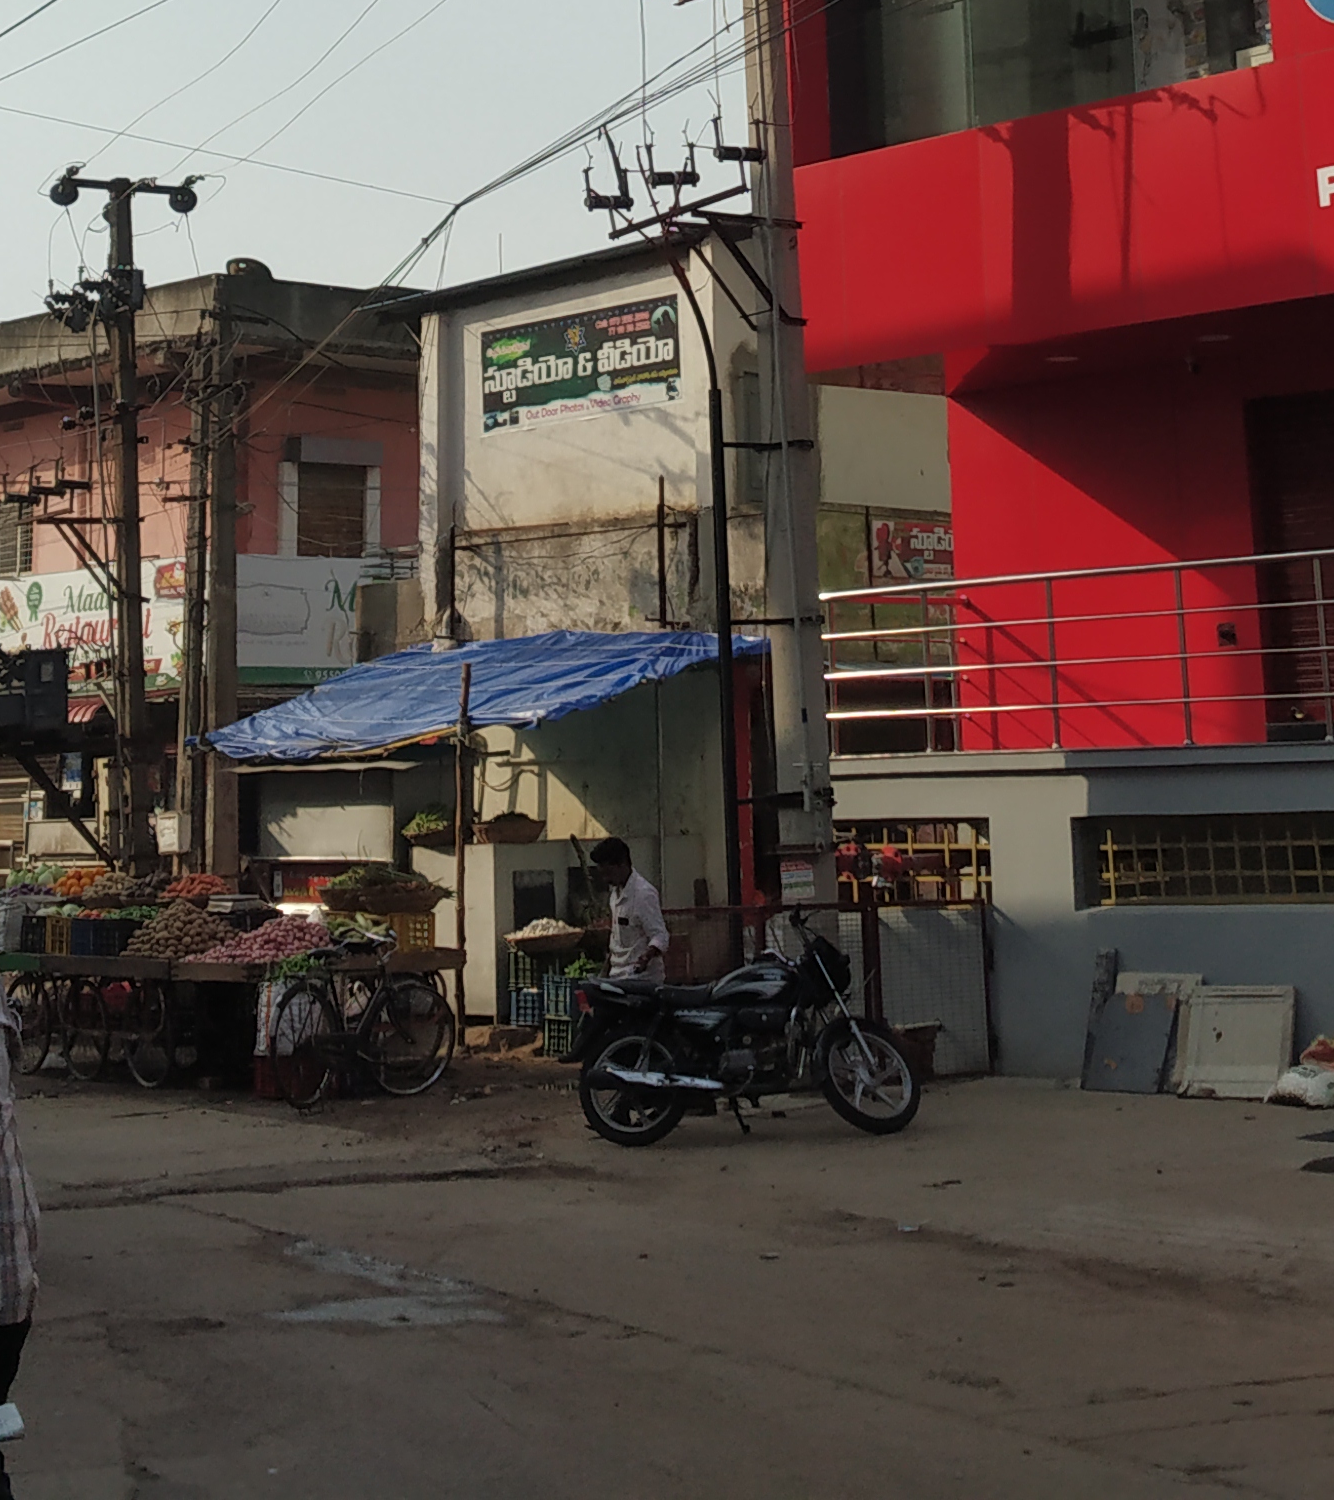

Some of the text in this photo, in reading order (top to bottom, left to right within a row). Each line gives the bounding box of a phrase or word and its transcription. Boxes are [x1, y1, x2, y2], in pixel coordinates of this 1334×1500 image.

[484, 355, 574, 404] స్టూడియో
[577, 352, 594, 377] &
[597, 336, 674, 373] వీడియో
[526, 409, 540, 420] Out
[541, 407, 558, 418] Door
[590, 397, 612, 409] Video
[613, 393, 641, 406] Graphy
